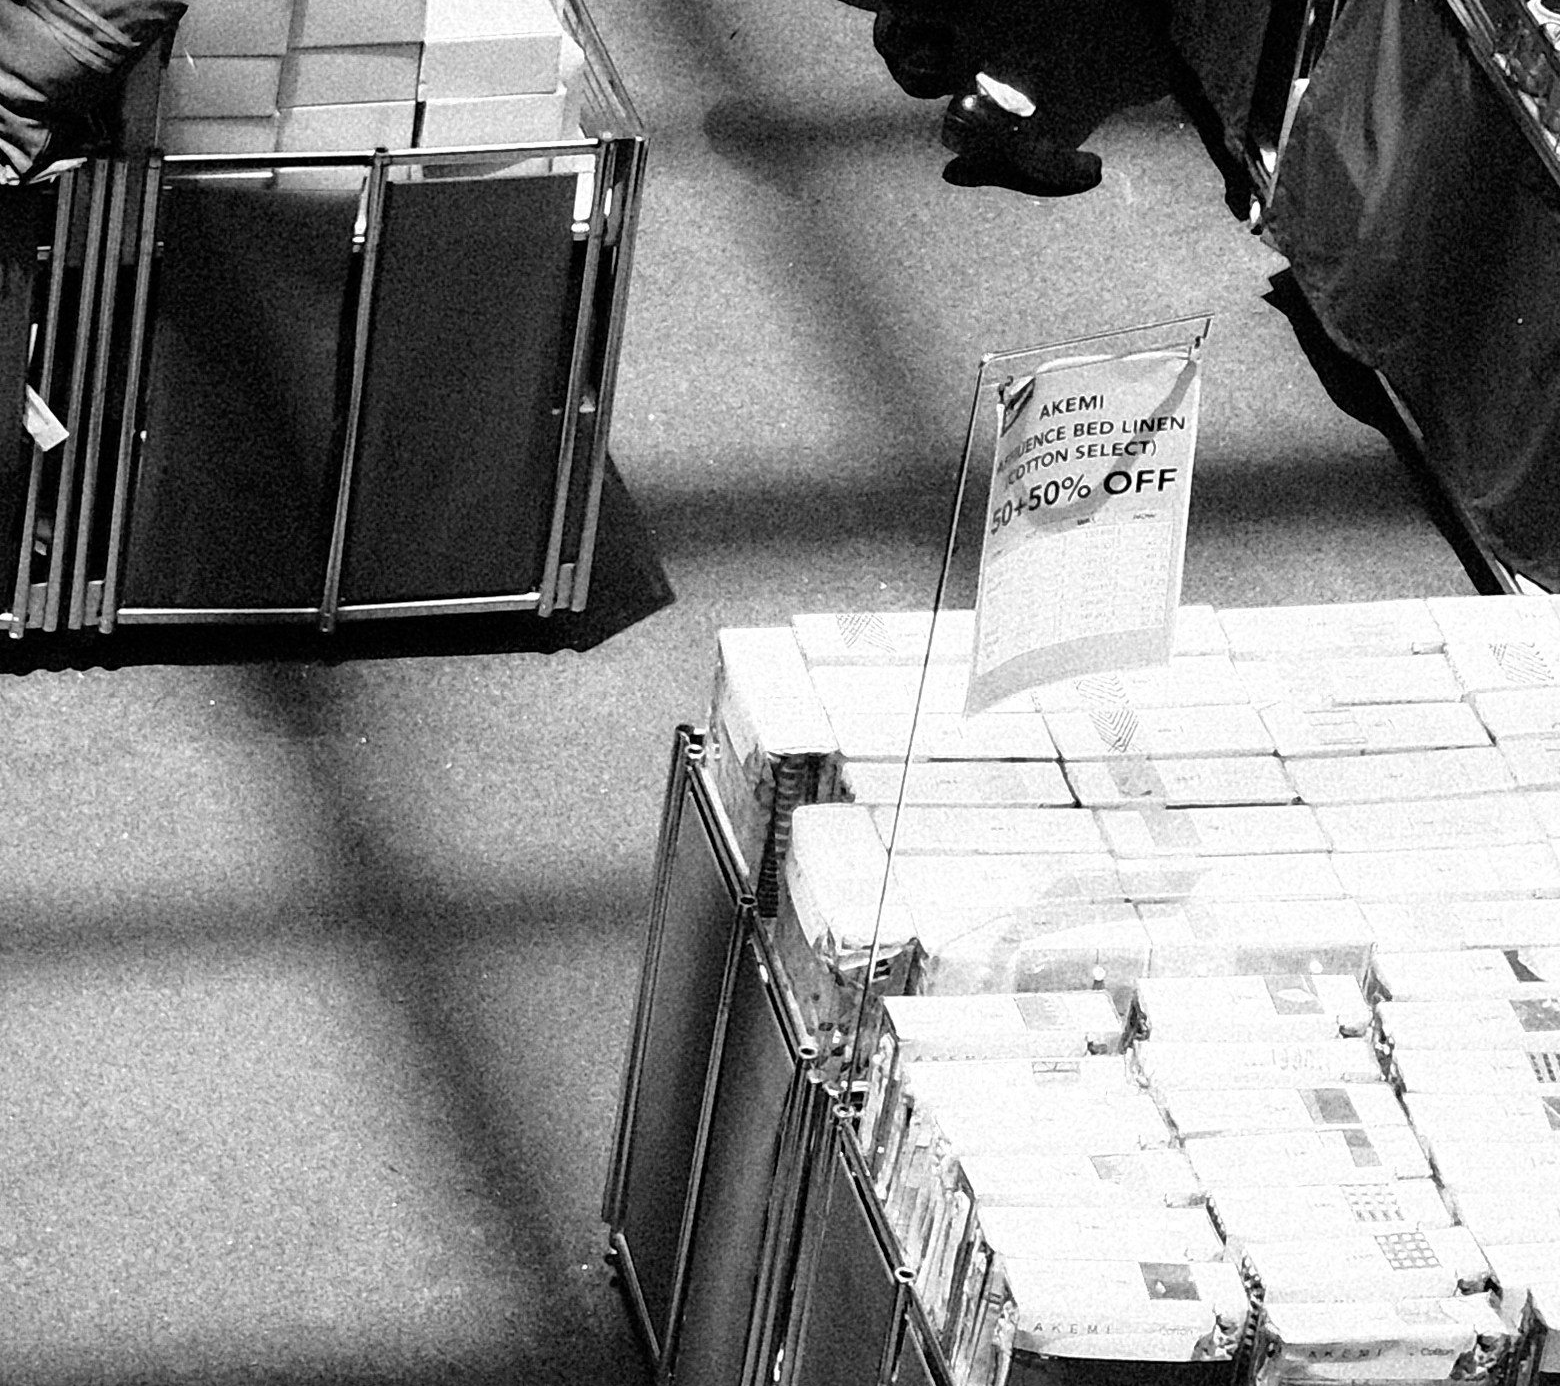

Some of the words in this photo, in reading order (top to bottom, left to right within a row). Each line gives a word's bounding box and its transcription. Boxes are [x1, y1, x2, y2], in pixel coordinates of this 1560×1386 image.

[1039, 395, 1104, 420] AKEMI
[1073, 421, 1114, 438] BED
[1122, 416, 1185, 434] LINEN
[1075, 439, 1156, 459] SELECT)
[991, 474, 1091, 535] 50+50%
[1103, 468, 1177, 495] OFF
[1034, 1320, 1112, 1336] AKEMI
[1308, 1347, 1383, 1361] AKEMI
[1421, 1346, 1456, 1357] Cotton
